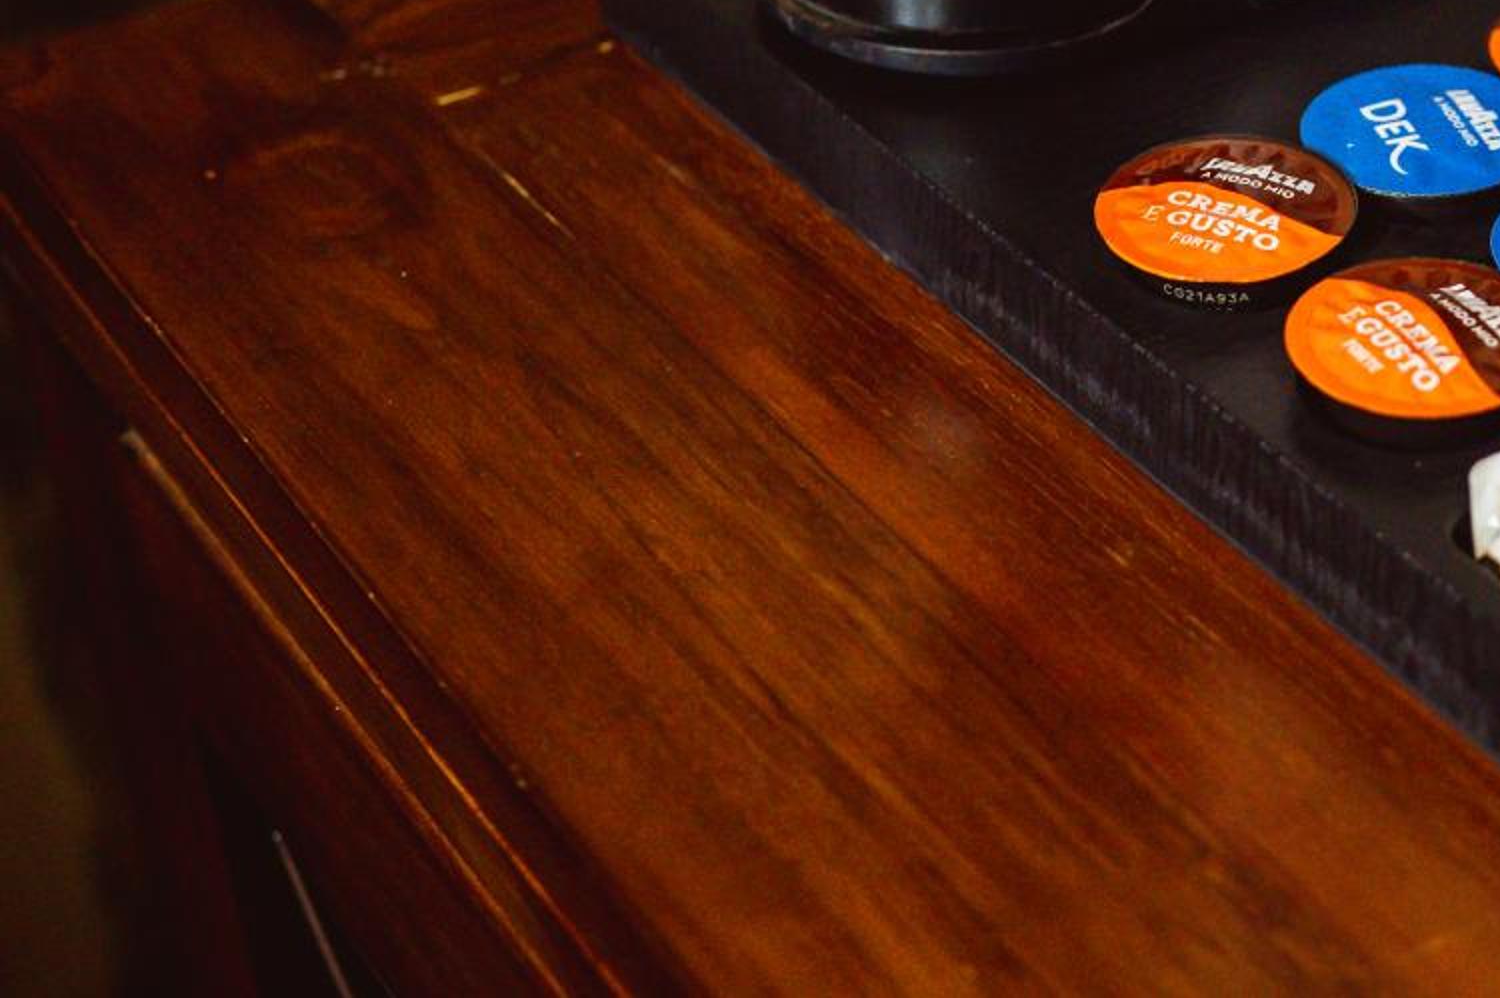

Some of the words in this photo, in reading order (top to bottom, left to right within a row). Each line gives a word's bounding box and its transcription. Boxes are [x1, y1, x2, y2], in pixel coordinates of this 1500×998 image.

[1359, 98, 1430, 176] DEK
[1199, 157, 1316, 195] LAVAZZA
[1214, 170, 1264, 190] MODO
[1263, 183, 1296, 200] MIO
[1140, 204, 1166, 221] E
[1165, 209, 1281, 252] GUSTO
[1166, 189, 1281, 232] CREMA
[1168, 230, 1226, 255] FORTE
[1374, 300, 1461, 375] CREMA
[1438, 298, 1477, 328] MODO
[1470, 325, 1500, 349] MIO
[1354, 317, 1441, 393] GUSTO
